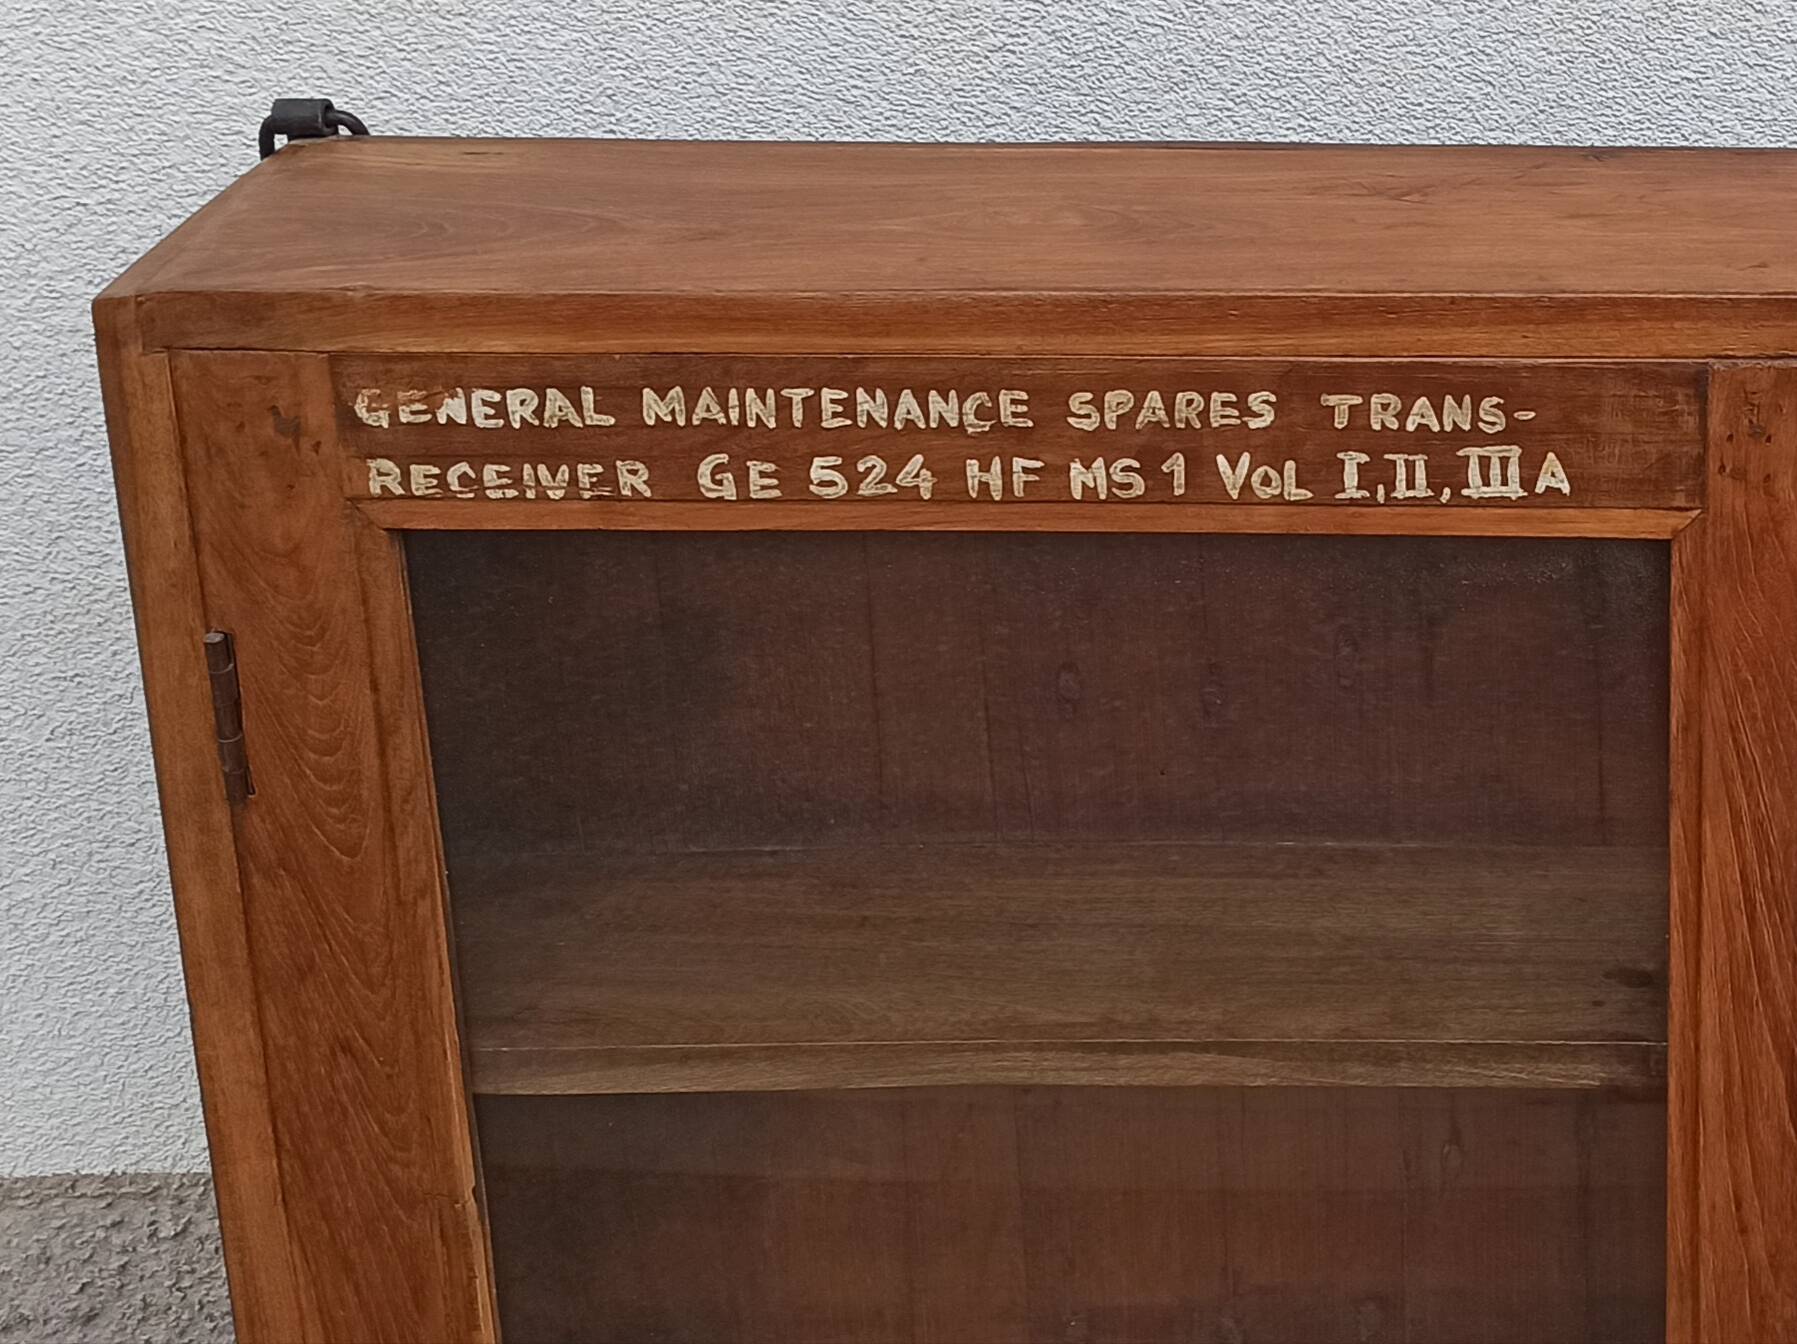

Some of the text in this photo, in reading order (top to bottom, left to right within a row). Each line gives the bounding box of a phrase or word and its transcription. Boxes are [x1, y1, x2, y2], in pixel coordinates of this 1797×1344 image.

[354, 385, 1536, 434] GENERAL MAINTENANCE SPARES TRANS-
[366, 457, 653, 500] RECEIVER
[697, 453, 782, 500] GE
[808, 454, 941, 500] 524
[965, 455, 1045, 501] HF
[1069, 457, 1146, 500] MS
[1160, 452, 1187, 496] 1
